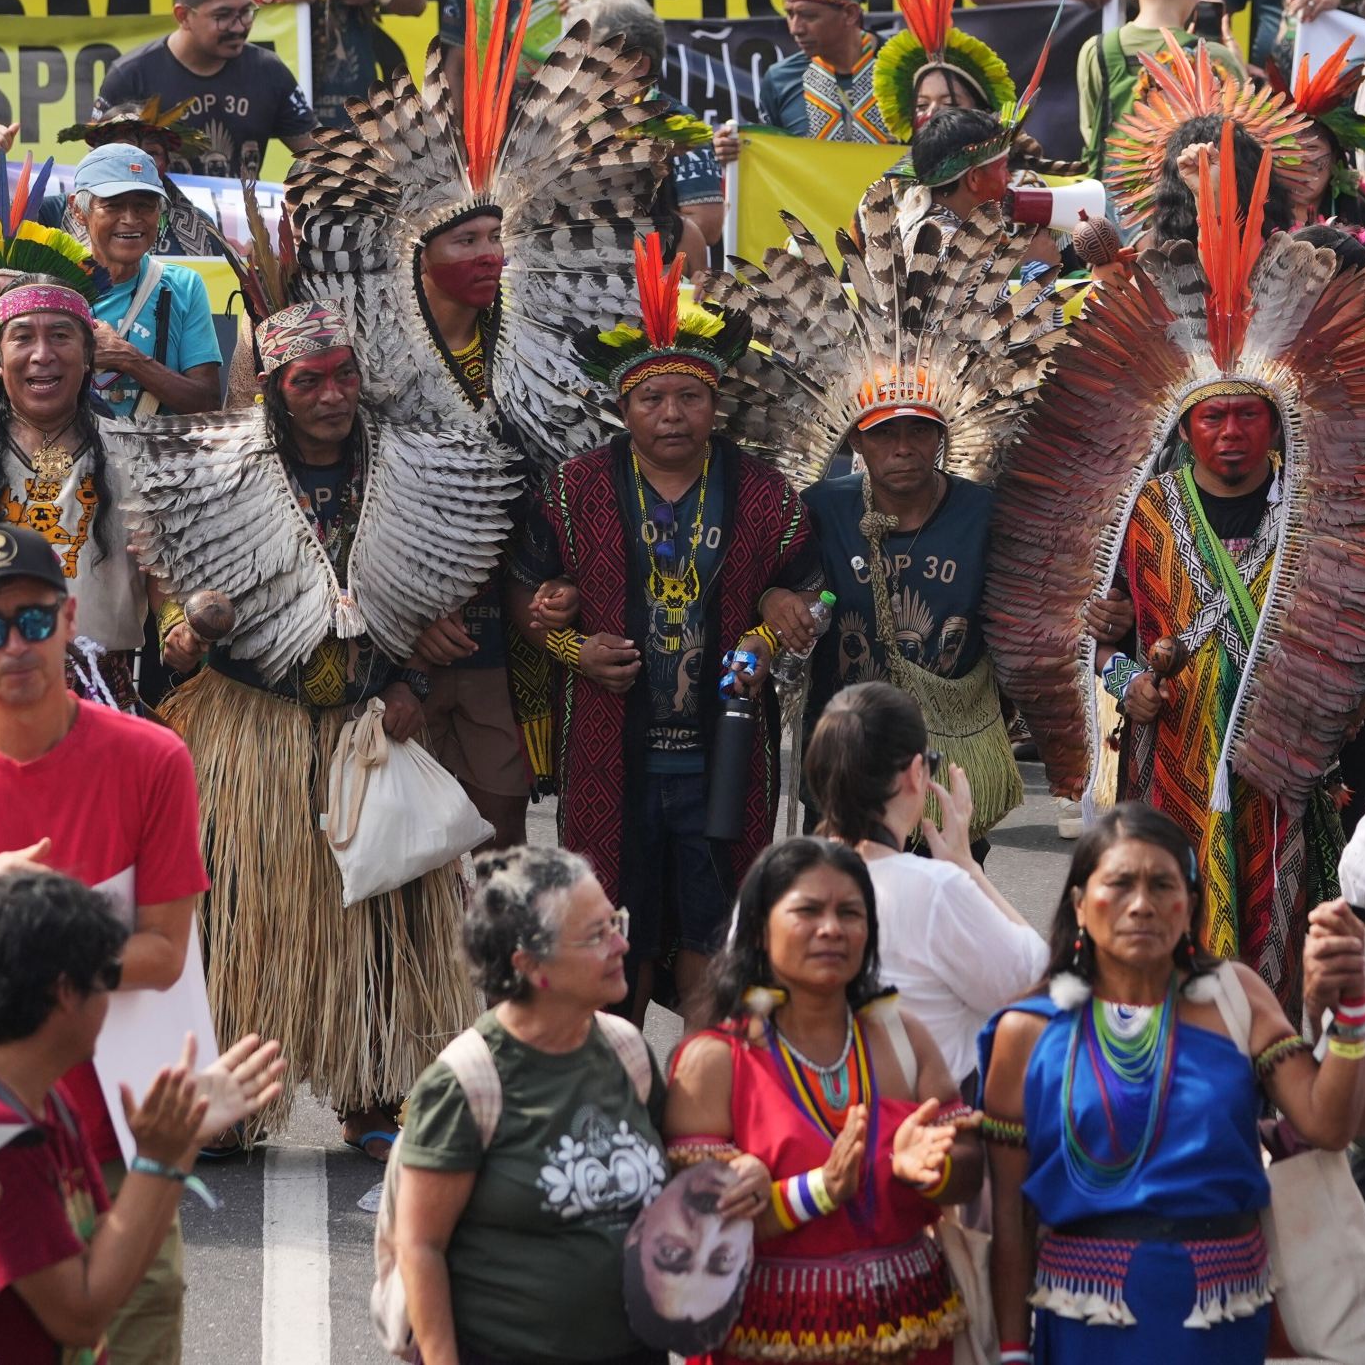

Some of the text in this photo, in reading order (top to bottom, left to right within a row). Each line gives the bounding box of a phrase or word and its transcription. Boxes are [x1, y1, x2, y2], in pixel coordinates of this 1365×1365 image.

[225, 94, 250, 117] 30
[689, 522, 722, 549] 30
[922, 555, 957, 584] 30
